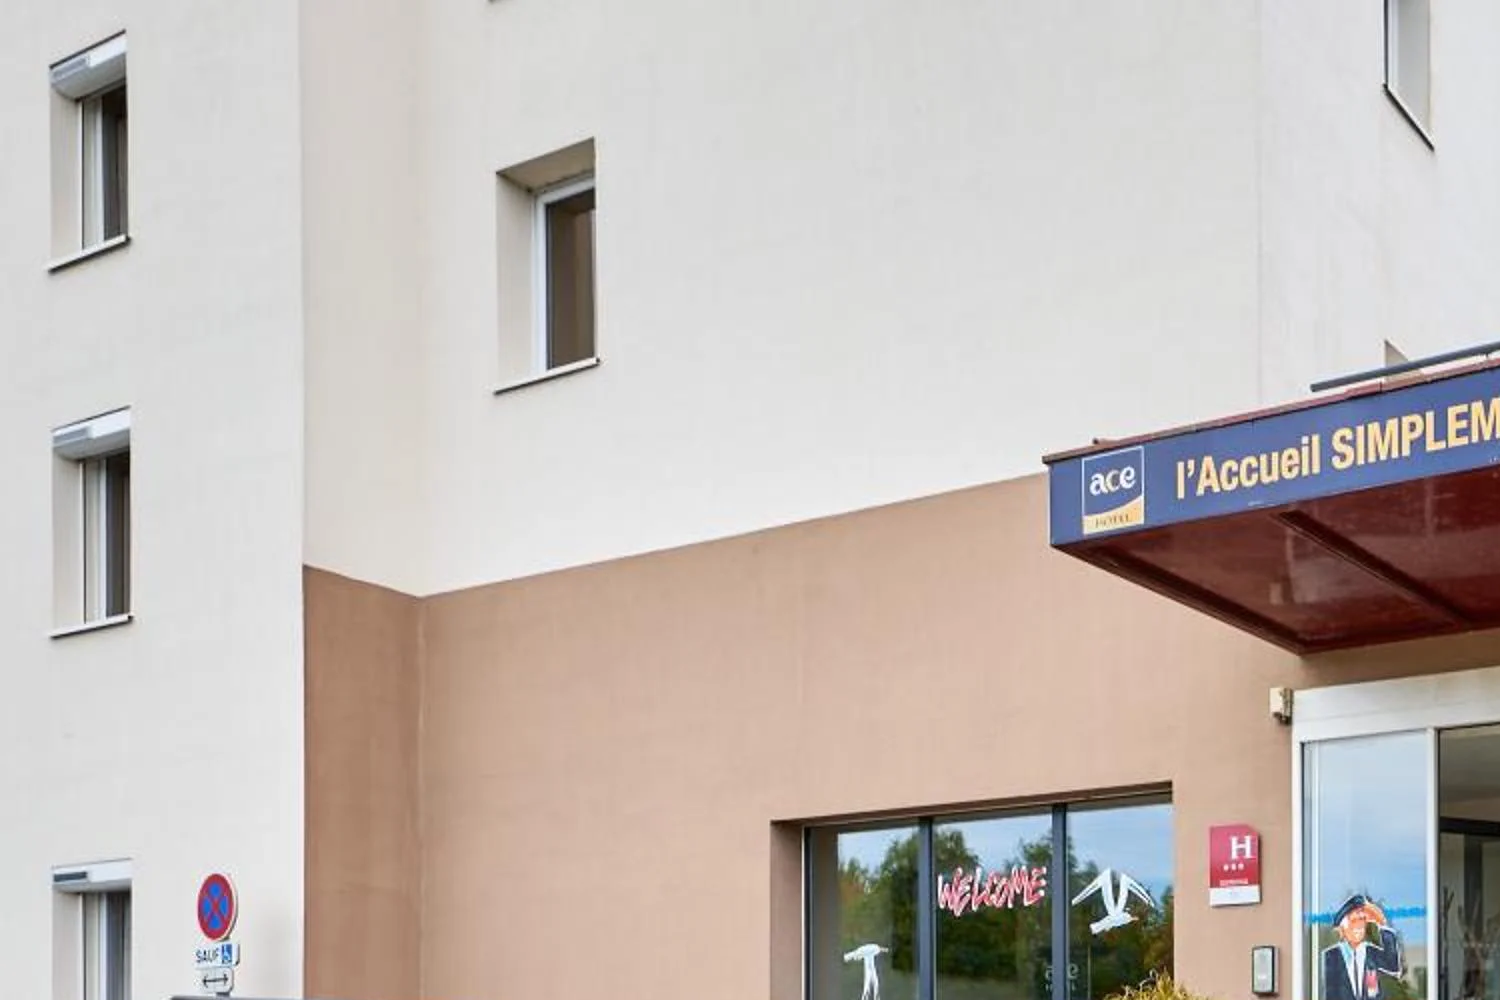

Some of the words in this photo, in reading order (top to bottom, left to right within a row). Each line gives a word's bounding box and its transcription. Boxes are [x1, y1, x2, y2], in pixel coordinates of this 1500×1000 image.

[1089, 466, 1137, 496] ace
[1177, 434, 1320, 499] l'Accueil
[1230, 834, 1257, 861] H
[937, 865, 1047, 917] WELCOME
